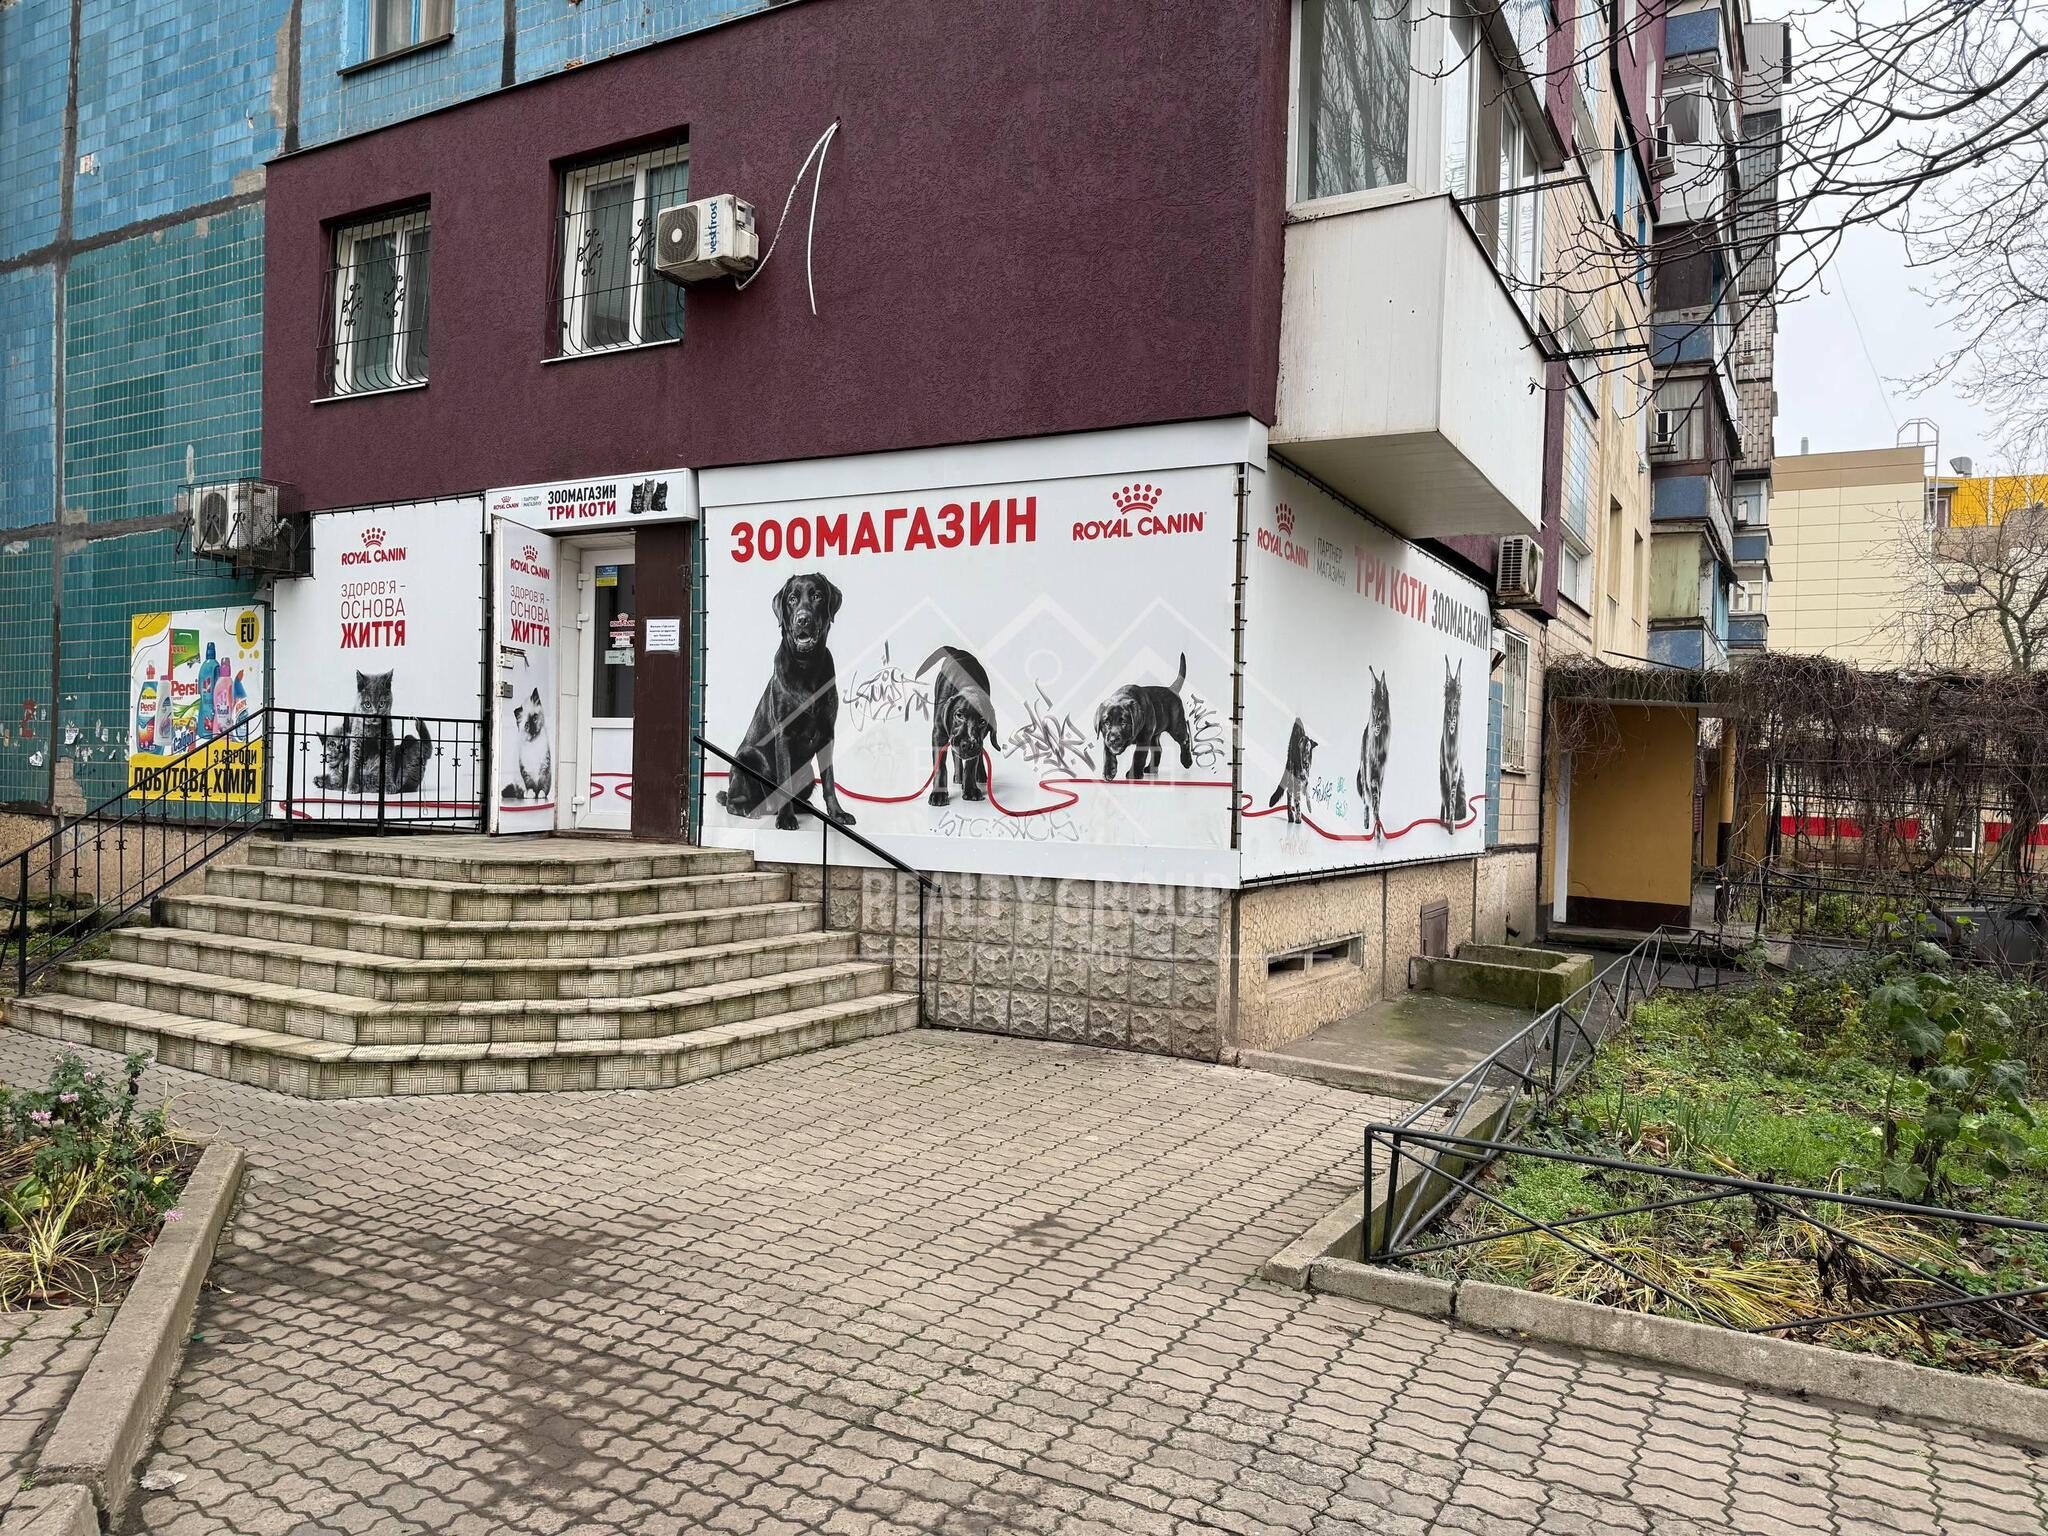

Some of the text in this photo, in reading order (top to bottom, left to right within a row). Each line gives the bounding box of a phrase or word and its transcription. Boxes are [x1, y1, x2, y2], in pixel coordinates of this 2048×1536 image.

[709, 200, 718, 254] vestfrost
[547, 484, 617, 504] ЗООМАГАЗИН
[547, 500, 617, 521] ТРИ КОТИ
[730, 496, 1037, 563] ЗООМАГАЗИН
[1072, 511, 1204, 541] ROYAL CANIN
[341, 547, 407, 566] ROYAL CANIN
[1257, 527, 1309, 569] ROYAL CANIN
[1317, 537, 1343, 564] ПАРТНЕР
[510, 558, 550, 580] ROYAL CANIN
[340, 597, 406, 620] ОСНОВА
[1354, 545, 1489, 652] ТРИ КОТИ ЗООМАГАЗИН
[510, 600, 550, 624] ОСНОВА
[240, 624, 255, 642] EU
[340, 620, 406, 648] ЖИТТЯ
[510, 619, 550, 647] ЖИТТЯ
[140, 701, 156, 711] Persil
[213, 750, 219, 763] З
[133, 767, 257, 794] ПОБУТОВА ХІМІЯ
